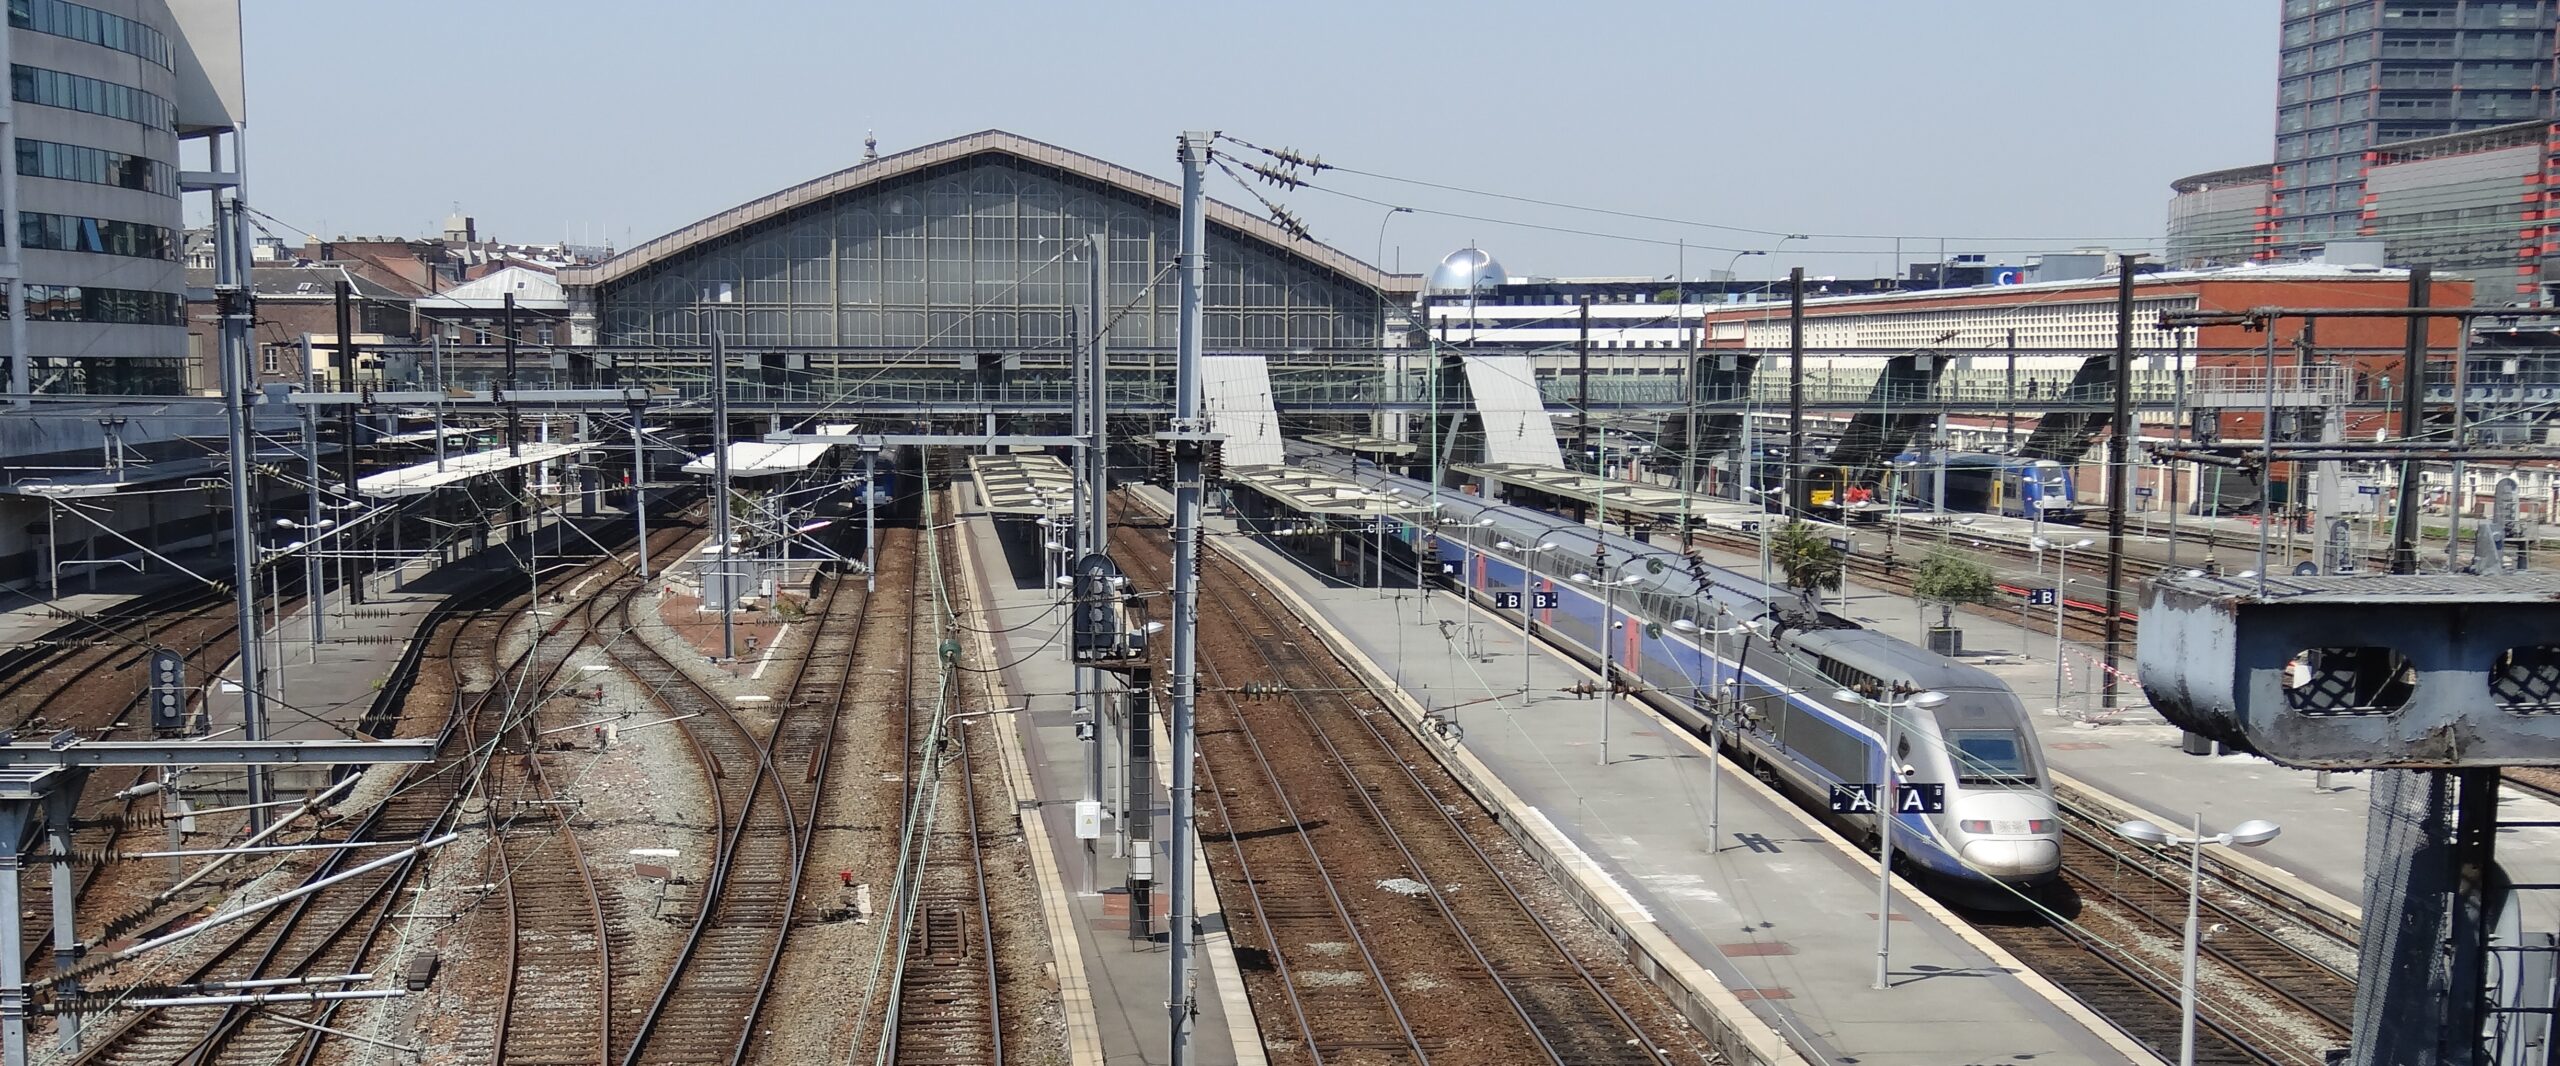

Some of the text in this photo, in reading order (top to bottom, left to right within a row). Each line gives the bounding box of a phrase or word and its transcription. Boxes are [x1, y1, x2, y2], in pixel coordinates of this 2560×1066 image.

[1367, 523, 1375, 533] C
[1508, 595, 1518, 607] B
[1536, 595, 1546, 607] B
[2042, 591, 2052, 604] B
[1850, 789, 1872, 811] A
[1903, 789, 1924, 811] A
